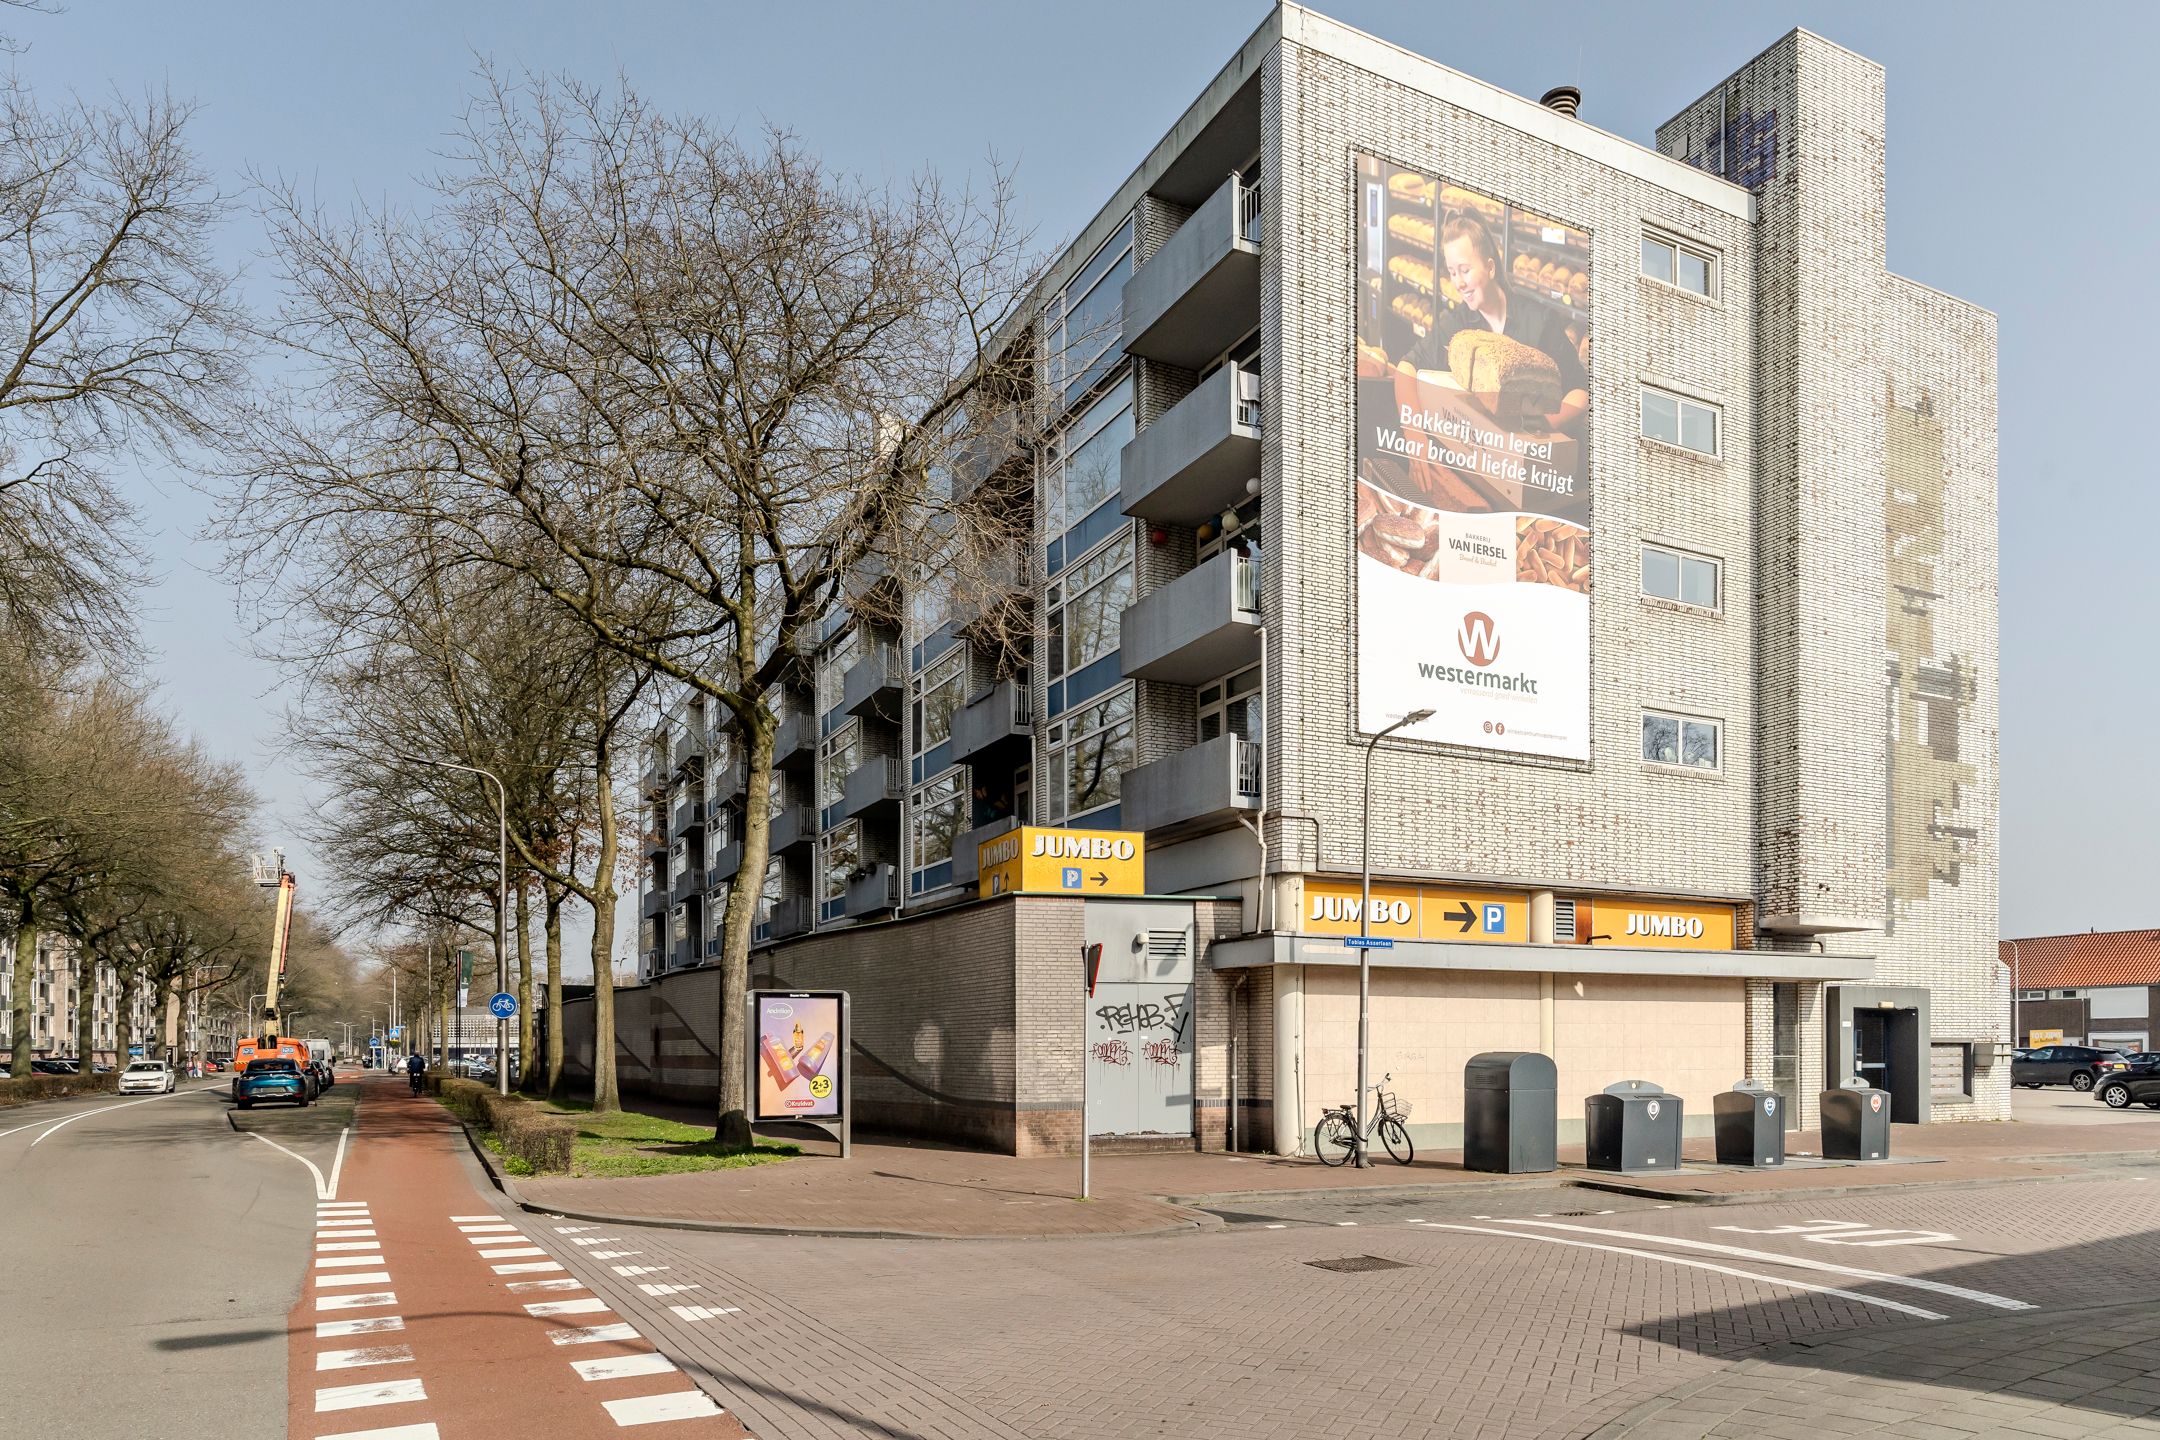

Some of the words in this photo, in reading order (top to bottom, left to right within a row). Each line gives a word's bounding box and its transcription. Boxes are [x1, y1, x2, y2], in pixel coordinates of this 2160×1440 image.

[1400, 404, 1469, 443] Bakkerij
[1475, 428, 1504, 448] van
[1509, 432, 1552, 461] Iersel
[1376, 427, 1424, 457] Waar
[1428, 439, 1477, 470] brood
[1482, 452, 1527, 481] liefde
[1531, 465, 1574, 494] krijgt
[1448, 537, 1470, 552] VAN
[1473, 543, 1507, 560] IERSEL
[1465, 532, 1491, 543] BAKKERIJ
[1418, 662, 1538, 695] westermarkt
[982, 837, 1019, 869] JUMBO
[1031, 835, 1135, 861] JUMBO
[1066, 870, 1080, 887] P
[1310, 896, 1412, 925] JUMBO
[1486, 907, 1502, 930] P
[1626, 913, 1704, 939] JUMBO
[812, 1079, 829, 1090] 2+3
